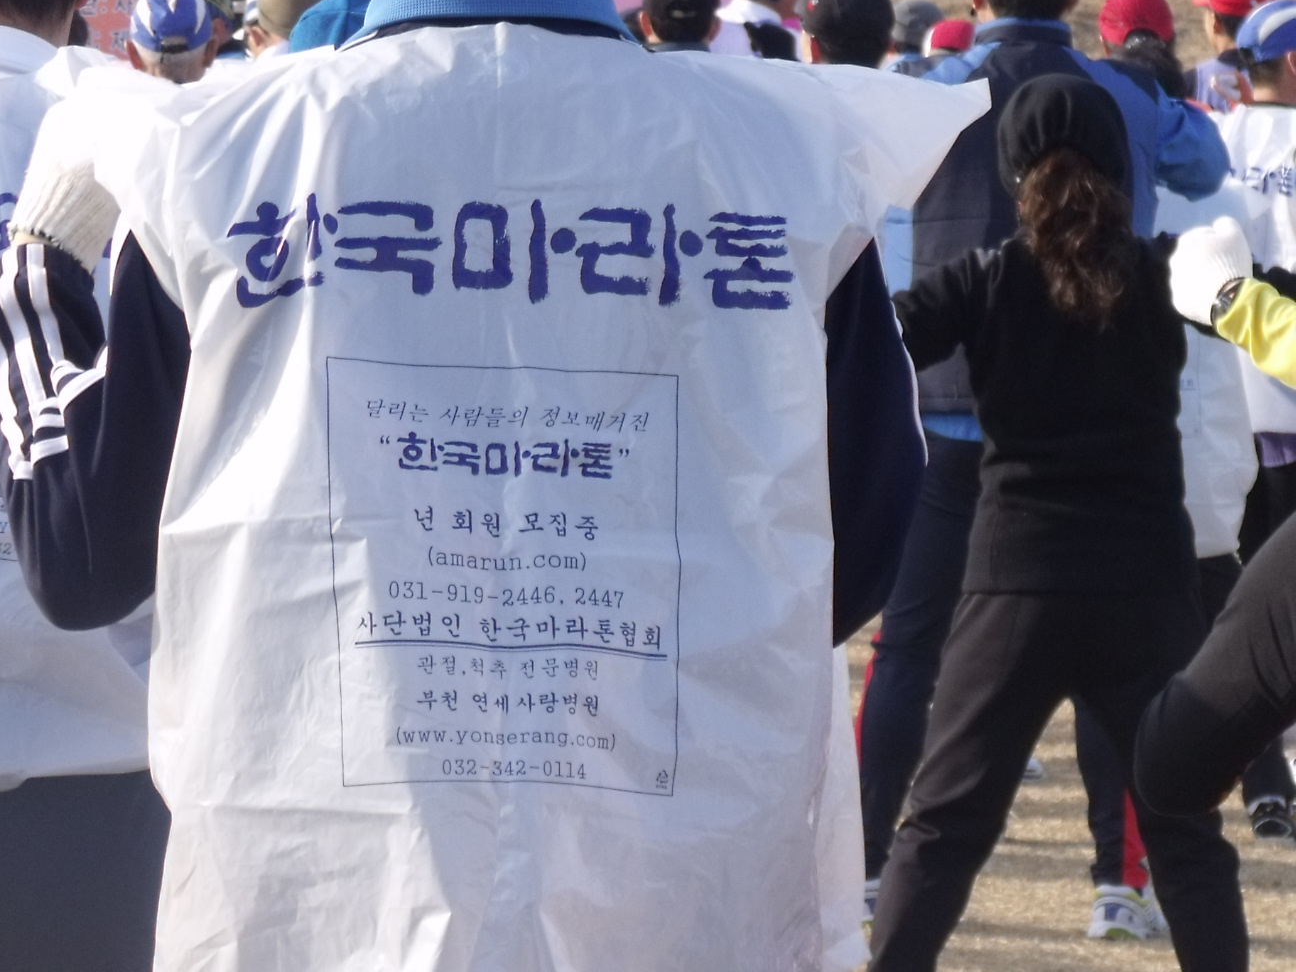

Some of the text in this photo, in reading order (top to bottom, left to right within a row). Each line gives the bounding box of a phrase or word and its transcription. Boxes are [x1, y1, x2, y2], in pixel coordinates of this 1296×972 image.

[226, 193, 794, 310] 한국마라톤
[366, 399, 649, 433] 달리는 사람들의 정보매거진
[415, 507, 599, 541] 년 회원 모집중
[428, 546, 587, 572] (amarun.com)
[574, 587, 624, 608] 2447
[357, 611, 661, 651] 사단법인 한국마라톤협회
[416, 690, 600, 717] 부천 연세사랑병원
[396, 726, 616, 752] (www.yonserang.com)
[442, 759, 587, 779] 032-342-0114
